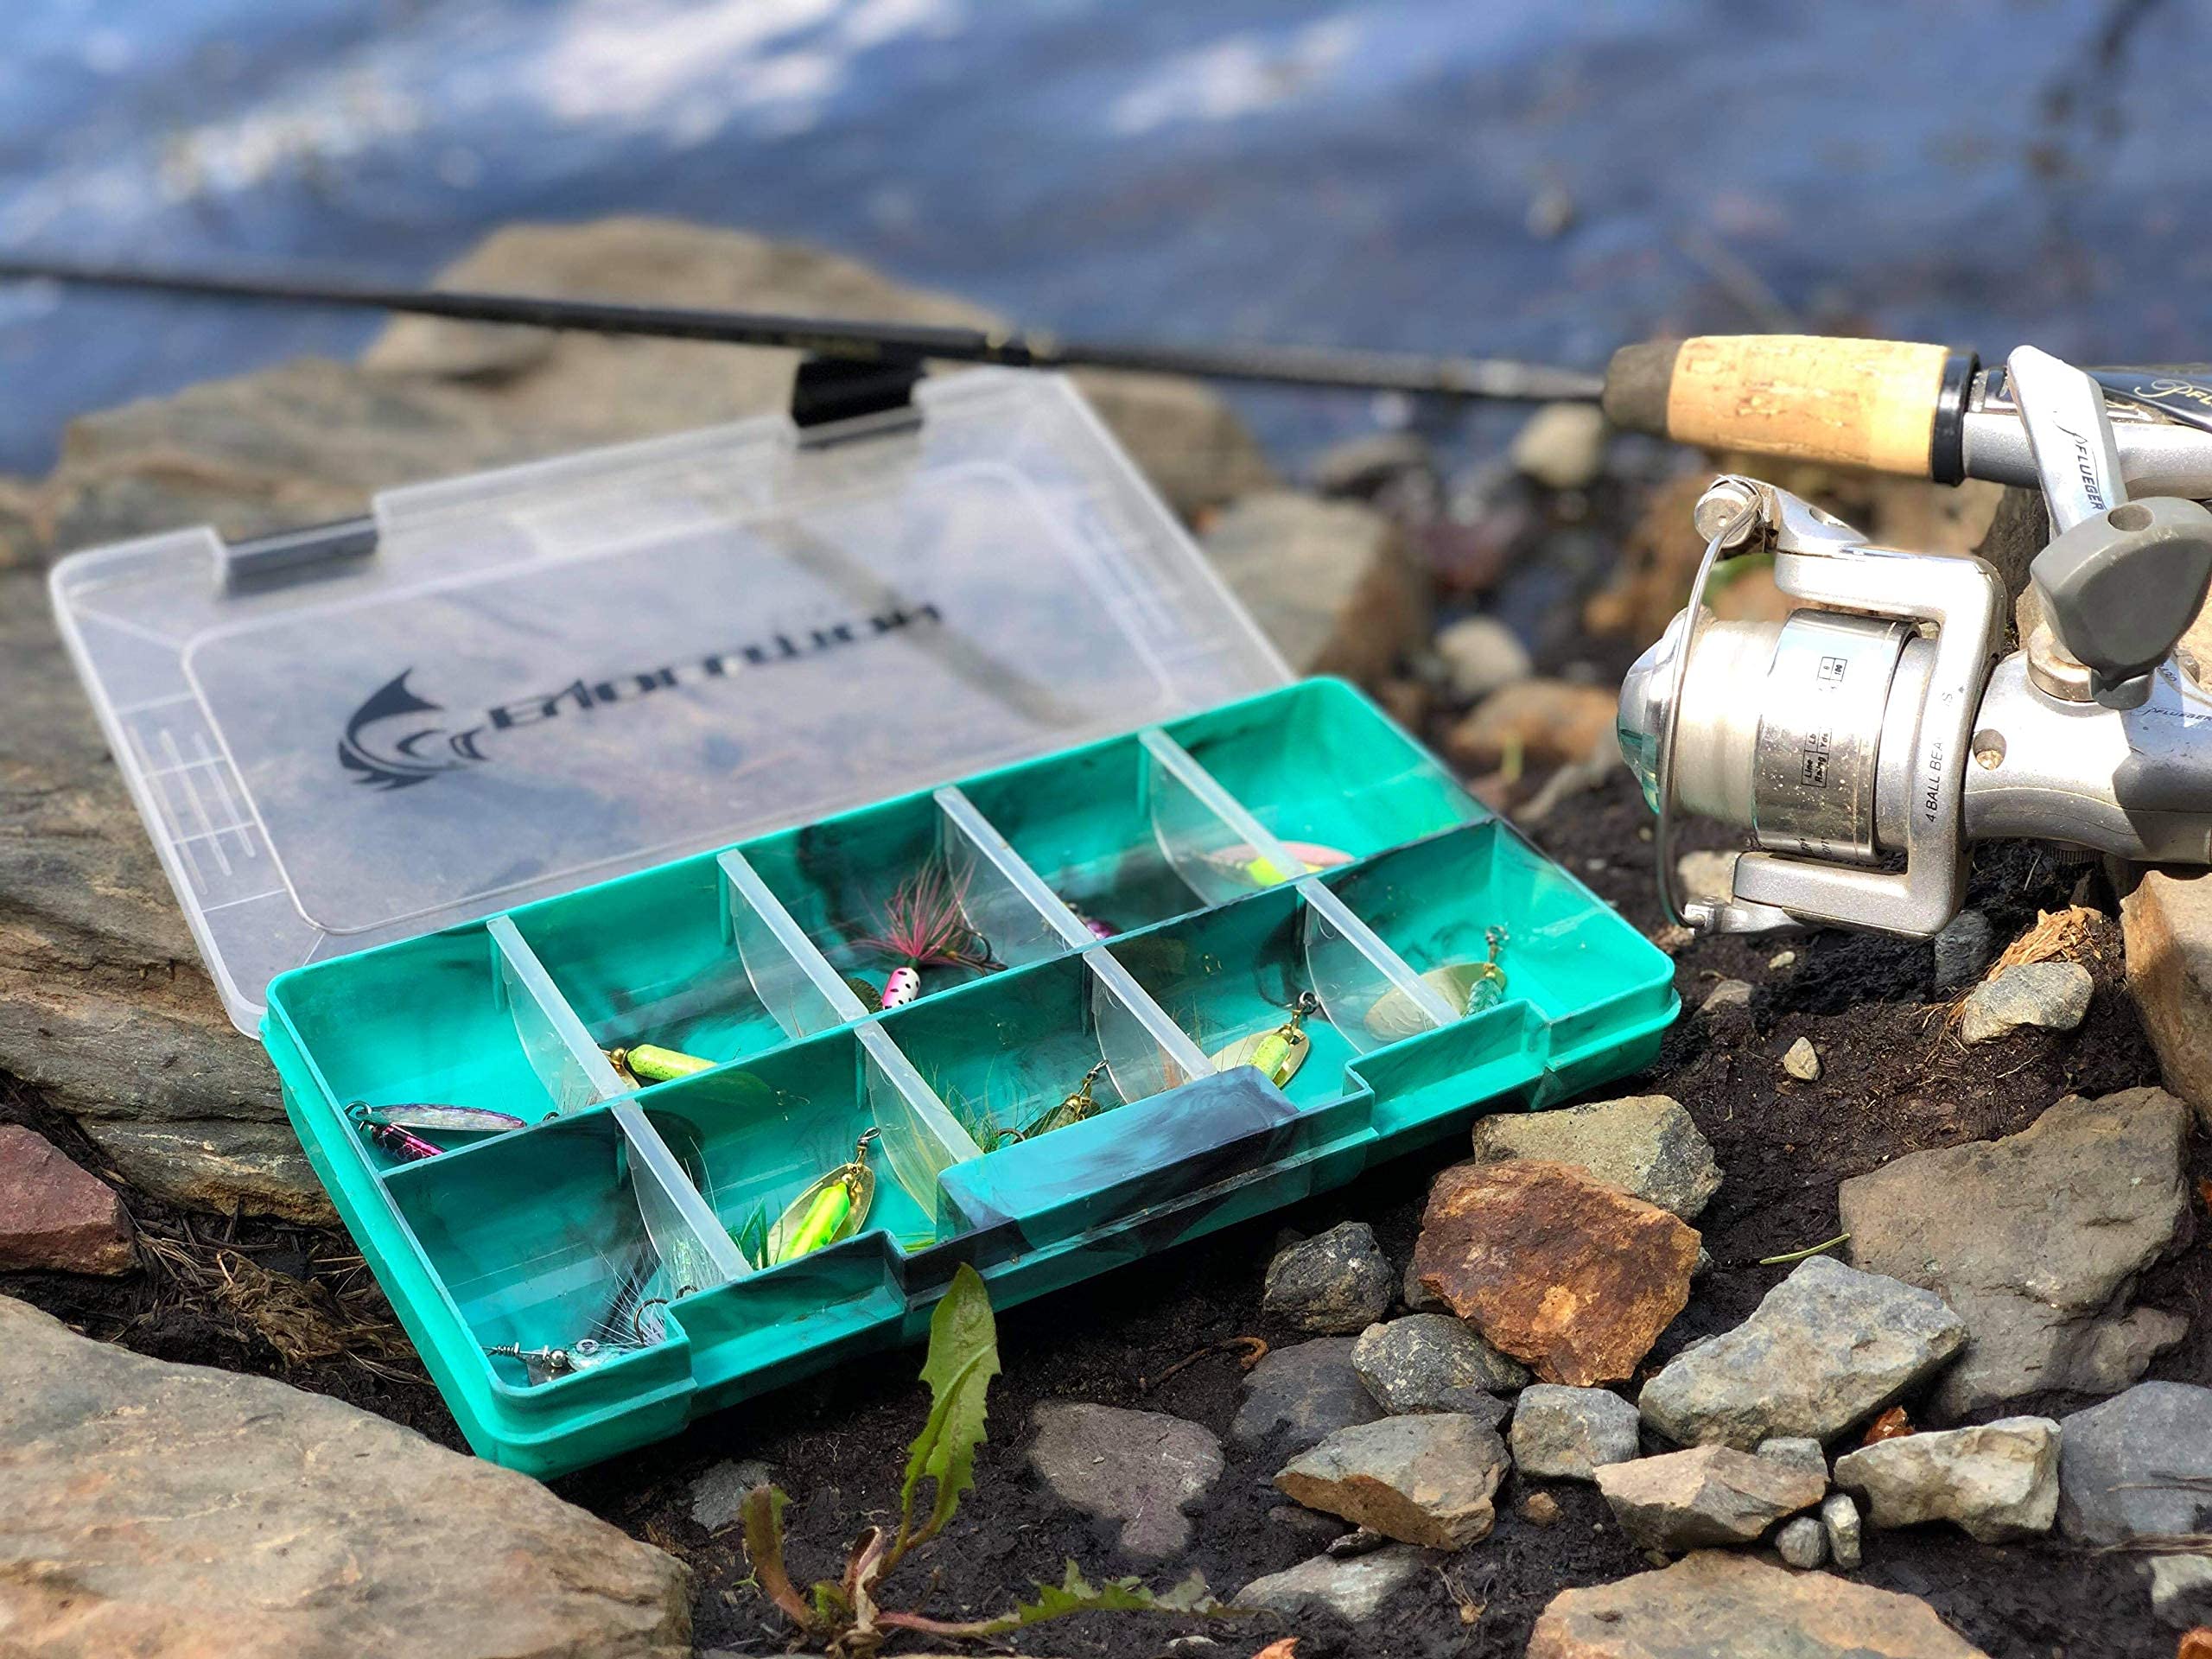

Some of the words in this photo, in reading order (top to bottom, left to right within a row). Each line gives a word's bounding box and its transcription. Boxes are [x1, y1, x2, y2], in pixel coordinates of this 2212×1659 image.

[2052, 420, 2106, 512] PFLUEGER
[1804, 759, 1813, 778] Line
[1925, 776, 1940, 810] BALL
[1925, 813, 1936, 822] 4
